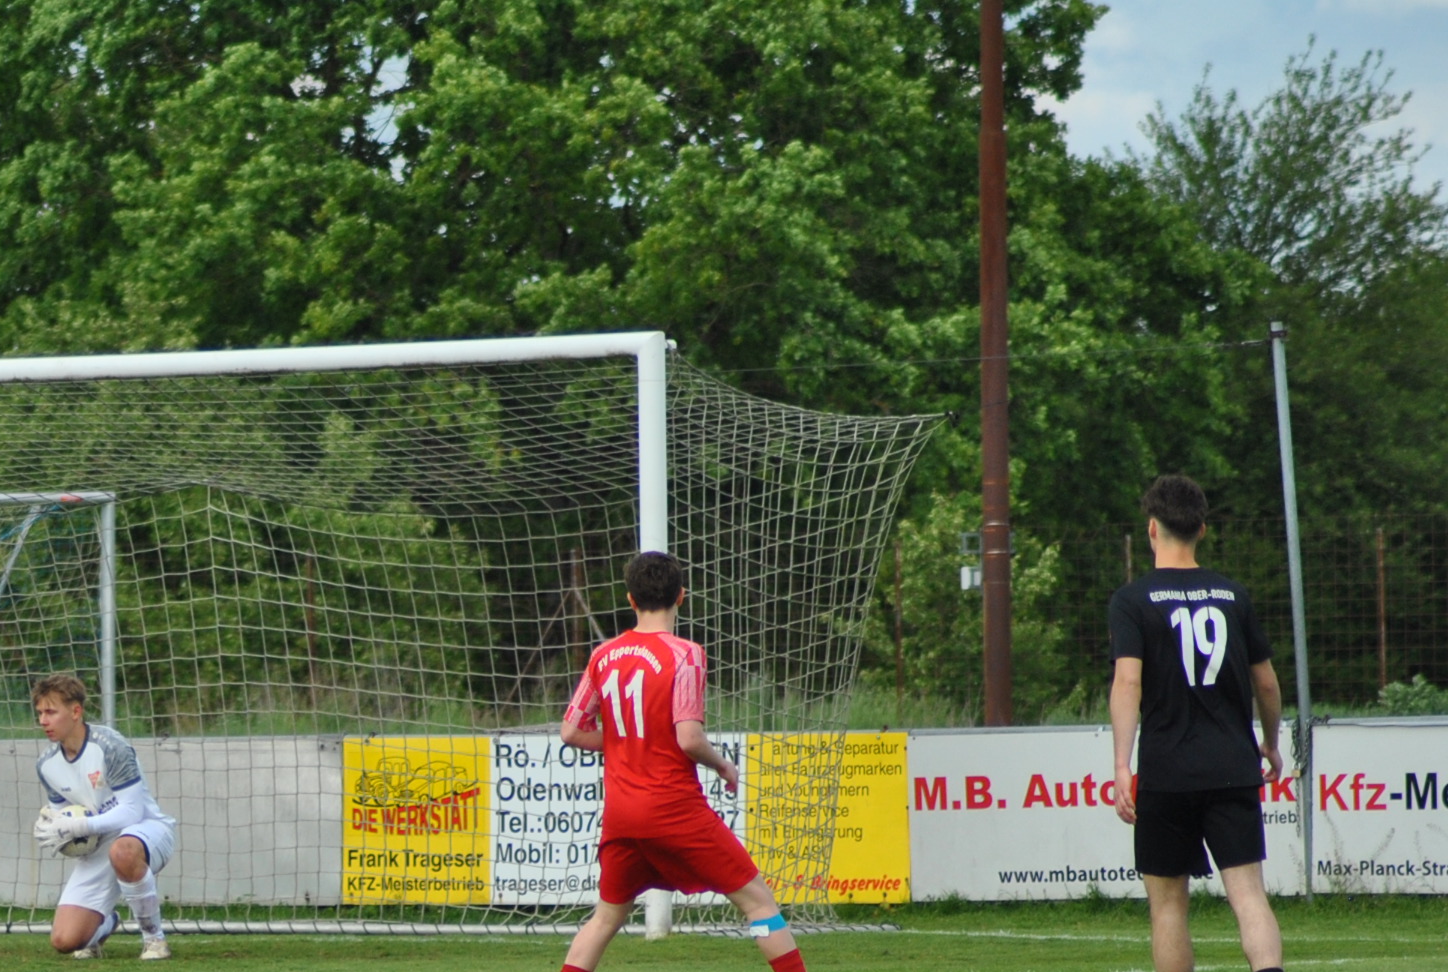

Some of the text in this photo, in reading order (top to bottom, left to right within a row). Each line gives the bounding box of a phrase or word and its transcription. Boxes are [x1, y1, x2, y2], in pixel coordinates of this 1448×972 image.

[1187, 589, 1236, 602] OBER-RODEN
[1170, 606, 1228, 687] 19
[602, 669, 645, 739] 11
[495, 743, 536, 768] Rö.
[914, 775, 1007, 811] M.B.
[352, 787, 481, 836] DIE WERKSTATT
[347, 848, 484, 873] Frank Trageser
[495, 843, 560, 865] Mobil:
[1317, 859, 1448, 877] Max-Planck-Str
[347, 875, 485, 892] KFZ-Meisterbetrieb
